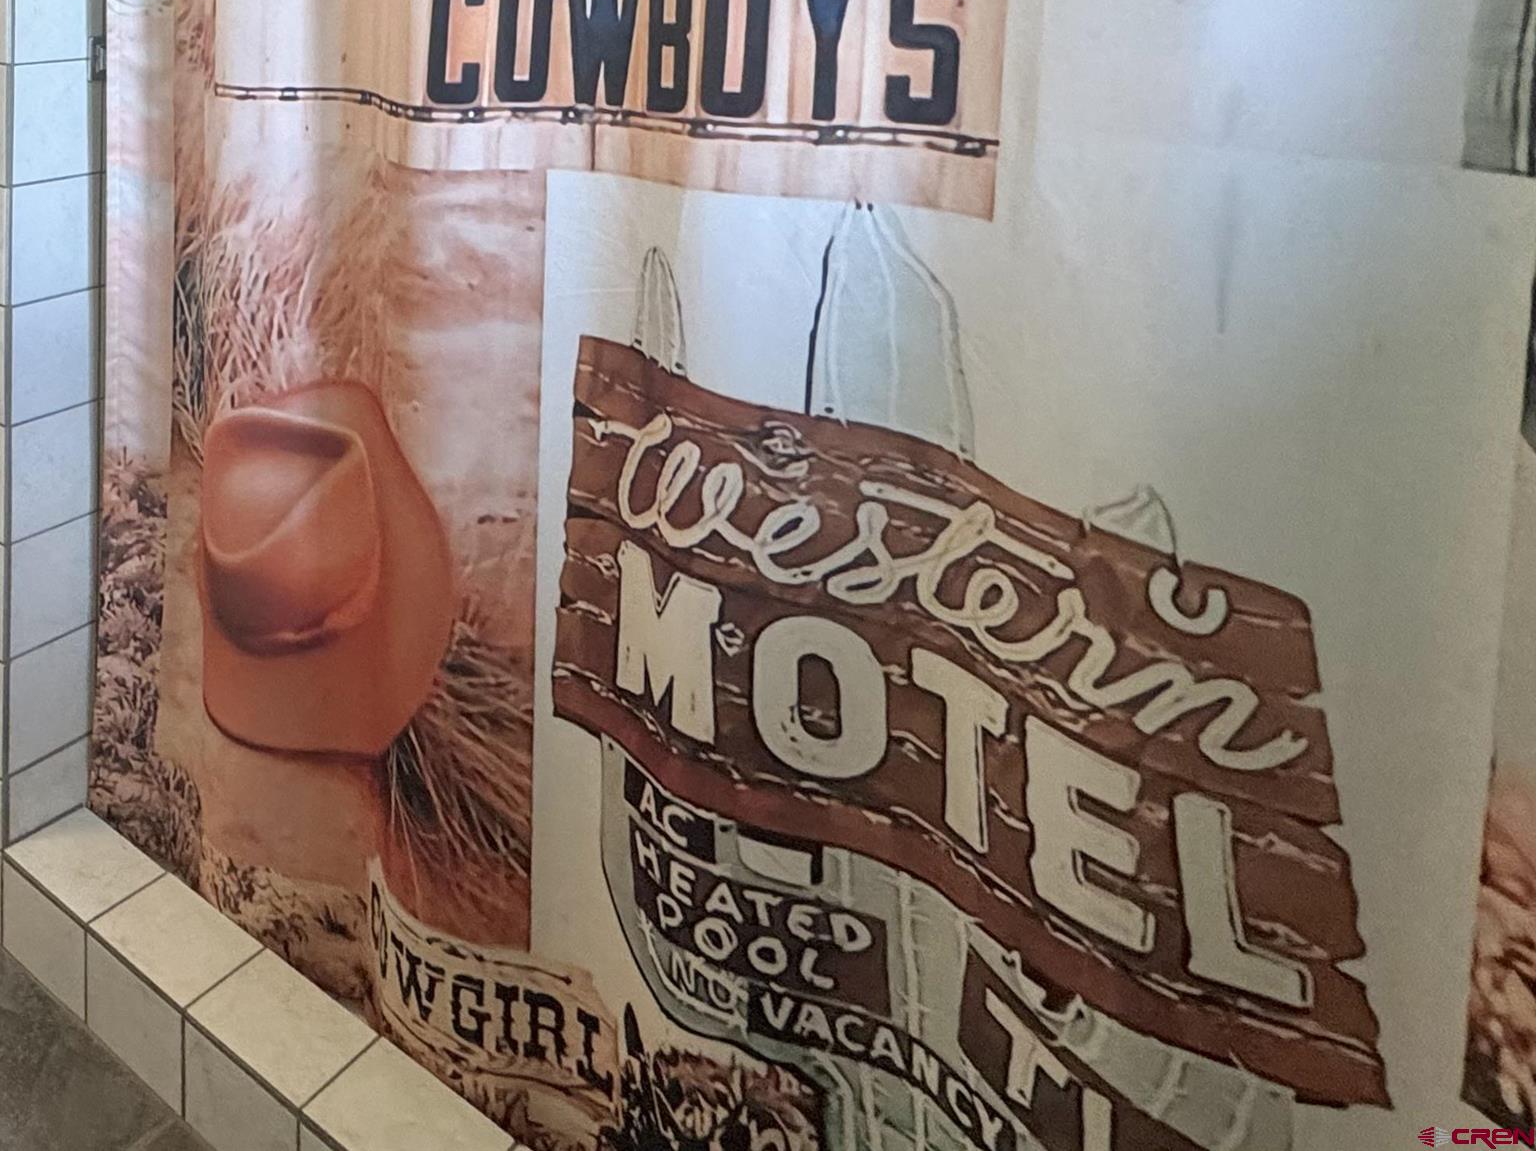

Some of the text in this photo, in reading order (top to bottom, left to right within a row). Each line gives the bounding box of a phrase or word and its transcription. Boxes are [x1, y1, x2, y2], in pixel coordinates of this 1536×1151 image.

[588, 412, 1309, 771] Western
[615, 540, 1314, 1009] MOTEL
[639, 786, 689, 848] AC
[633, 831, 873, 951] HEATED
[657, 893, 837, 990] POOL
[760, 991, 1003, 1150] VACANCY
